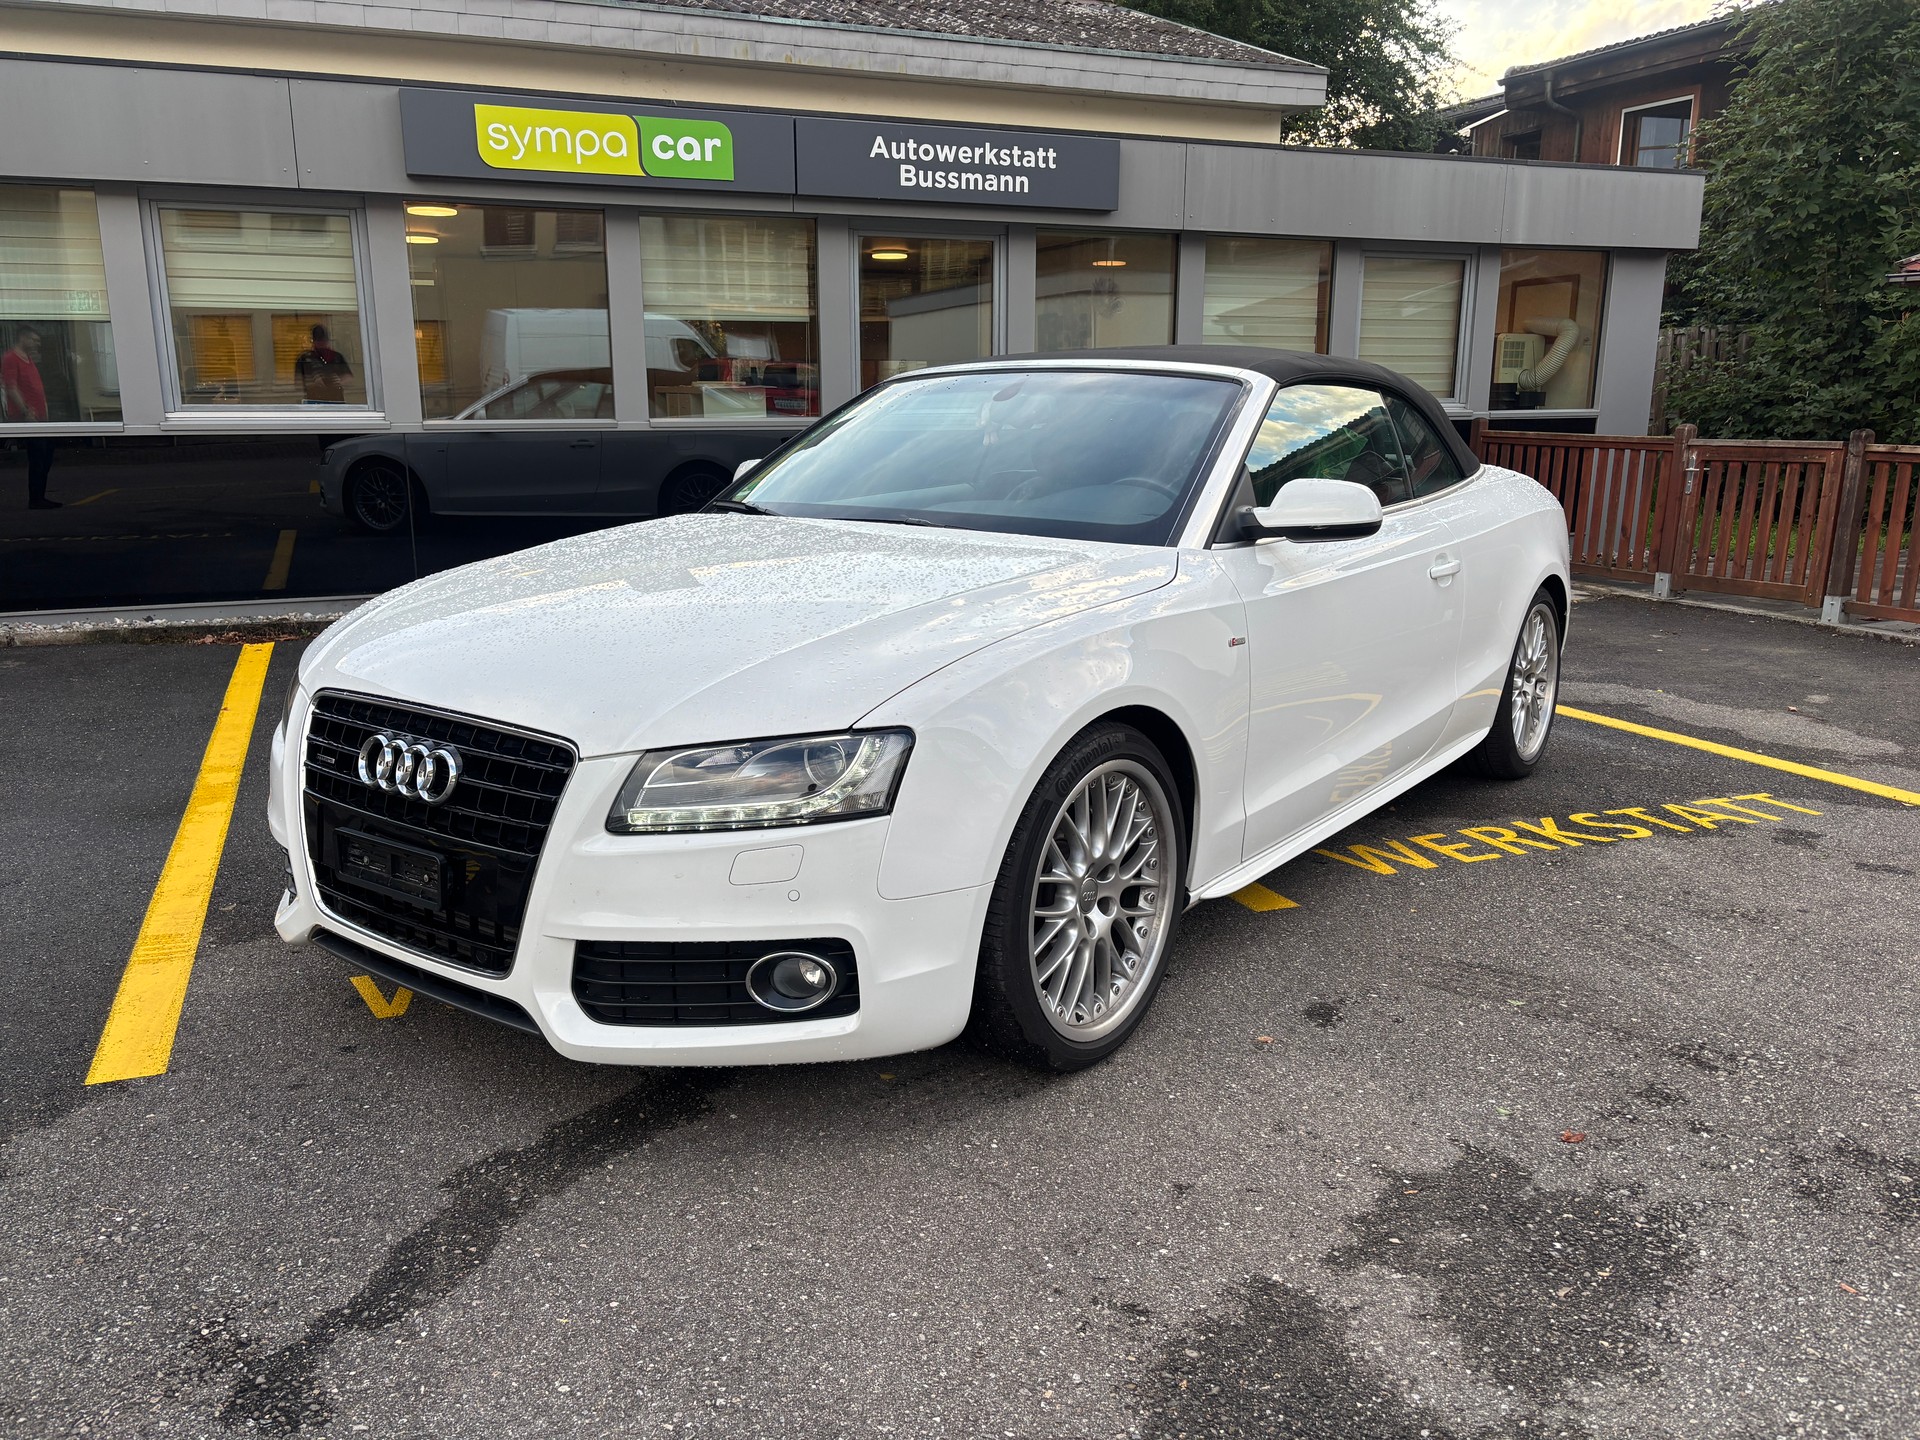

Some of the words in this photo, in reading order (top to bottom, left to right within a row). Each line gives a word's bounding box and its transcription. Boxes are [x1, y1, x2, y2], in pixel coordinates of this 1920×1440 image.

[487, 122, 628, 165] sympa
[651, 134, 722, 162] car
[869, 135, 1057, 169] Autowerkstatt
[900, 164, 1030, 194] Bussmann
[1314, 792, 1824, 876] WERKSTATT
